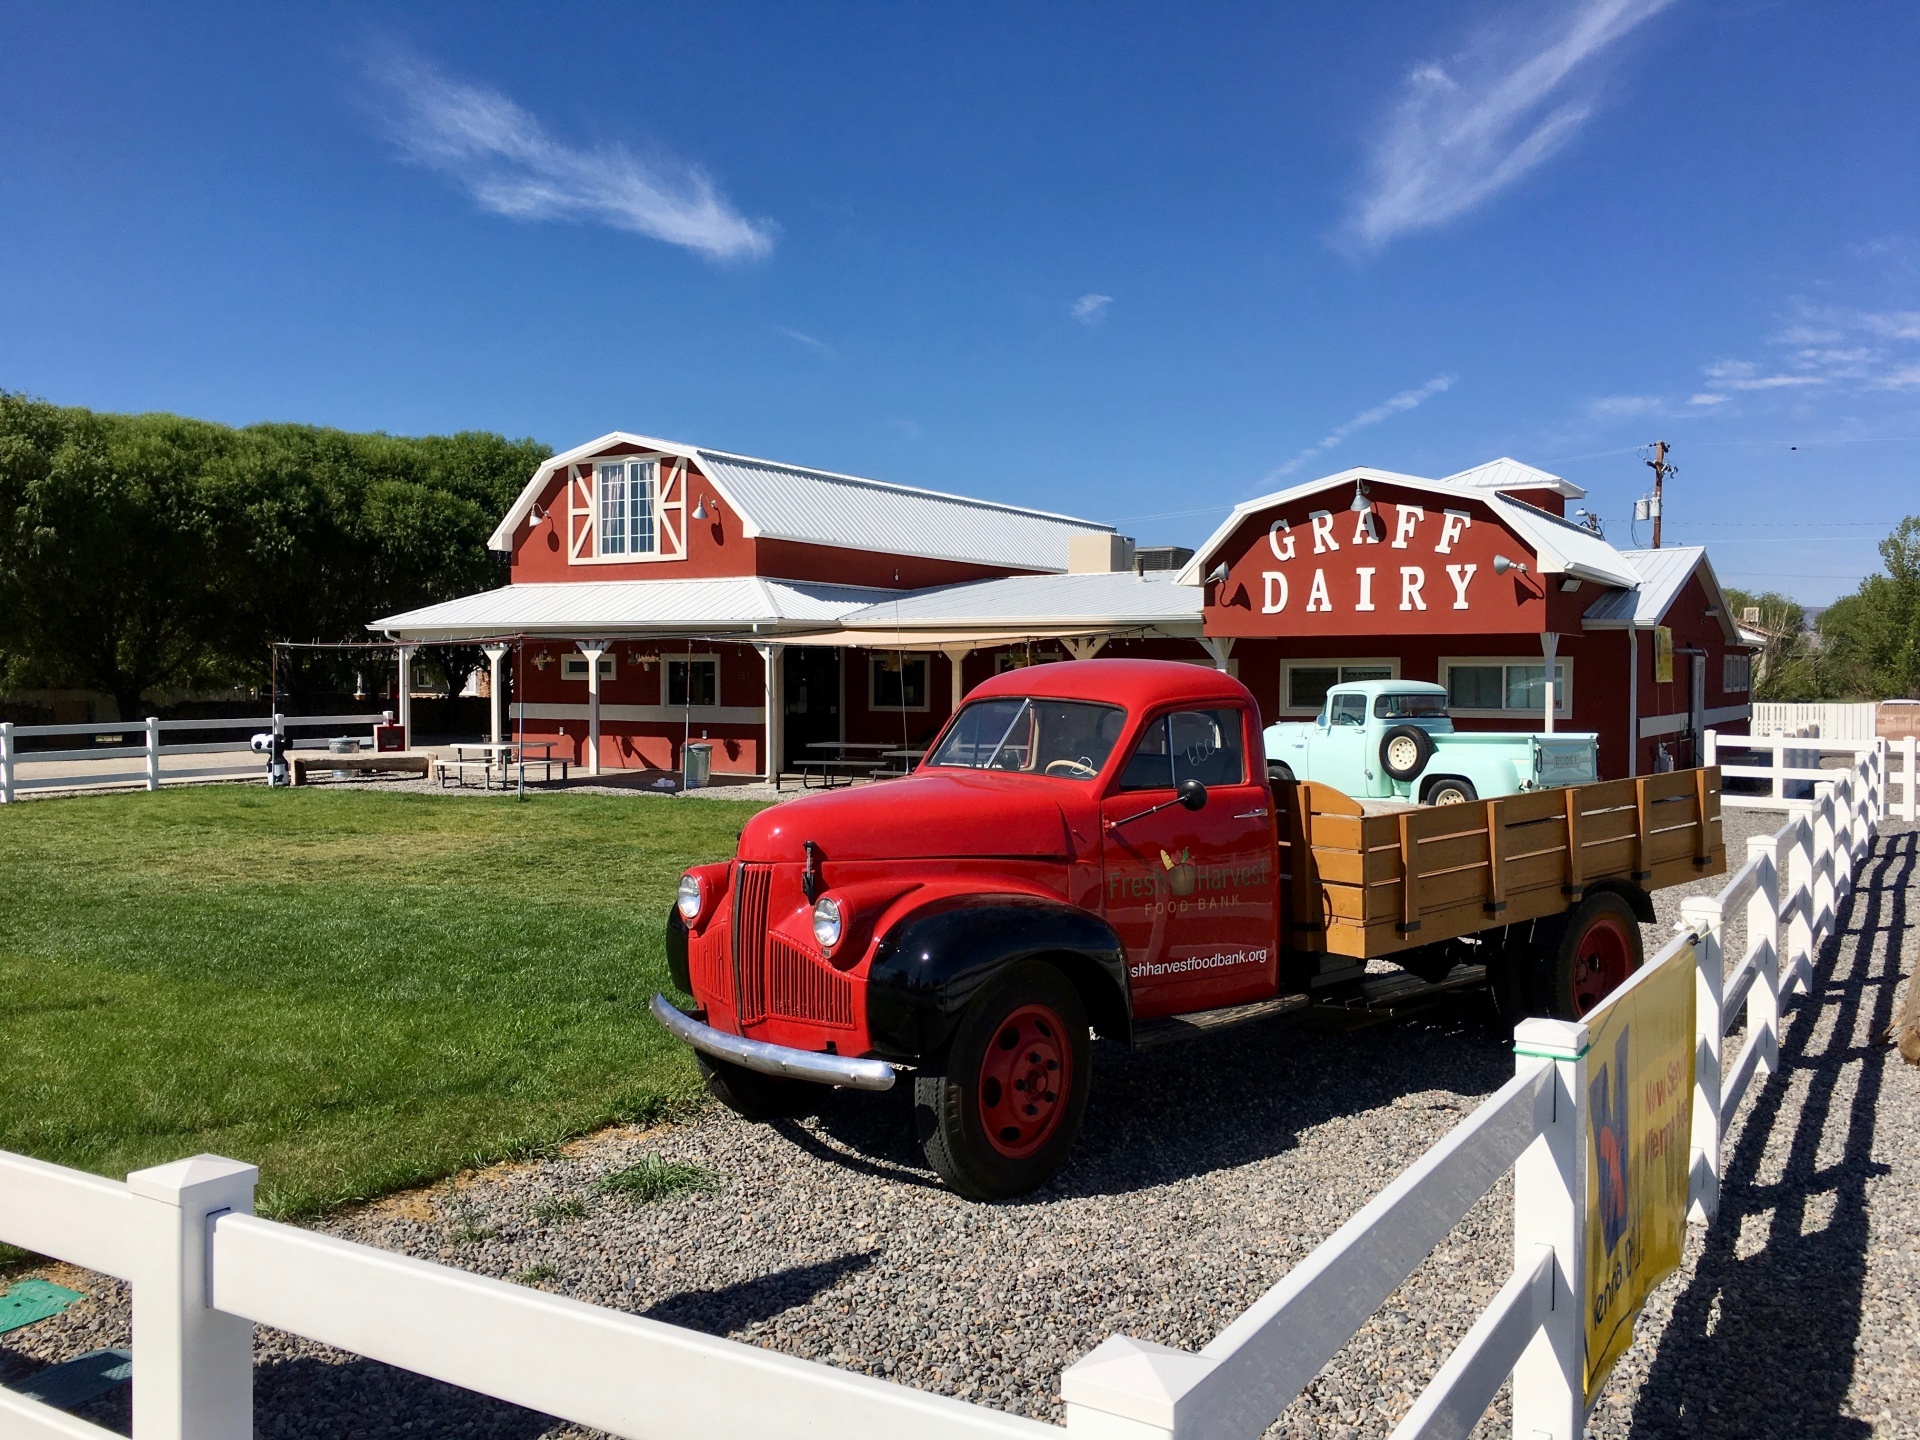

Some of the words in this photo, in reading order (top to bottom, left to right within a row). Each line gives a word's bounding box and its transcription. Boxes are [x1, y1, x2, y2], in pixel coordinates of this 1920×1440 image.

[1269, 504, 1471, 561] GRAFF
[1261, 564, 1477, 614] DAIRY
[1555, 755, 1578, 766] DODGE
[1109, 868, 1168, 899] Fresh
[1197, 860, 1268, 891] Harvest
[1144, 900, 1188, 915] FOOD
[1198, 894, 1239, 910] BANK
[1130, 949, 1267, 978] shharvestfoodbank.org
